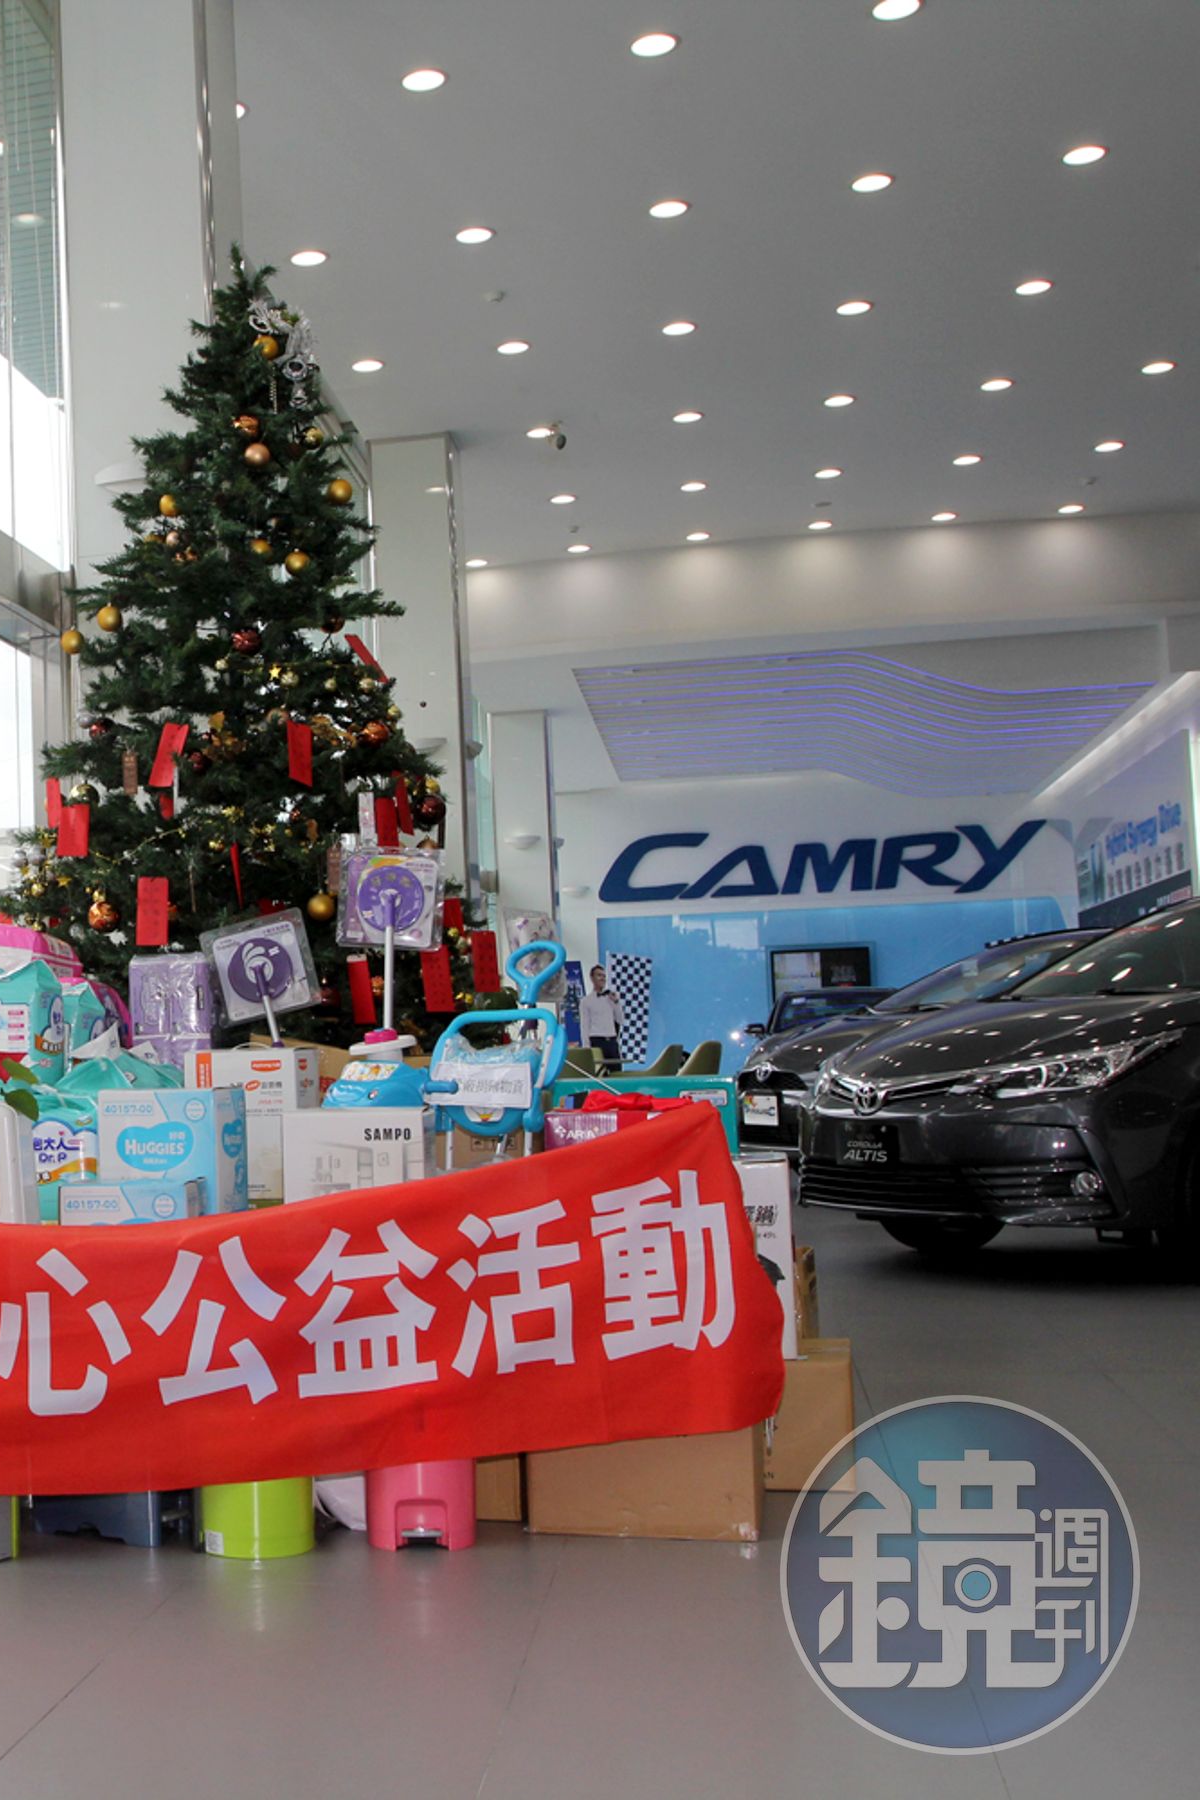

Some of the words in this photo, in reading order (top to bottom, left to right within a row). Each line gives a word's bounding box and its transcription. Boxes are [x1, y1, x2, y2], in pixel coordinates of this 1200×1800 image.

[599, 818, 1047, 902] CAMRY
[104, 1104, 152, 1114] 40157-00
[364, 1127, 412, 1141] SAMPO
[124, 1139, 185, 1156] HUGGIES
[847, 1140, 883, 1149] COROLLA
[843, 1149, 888, 1163] ALTIS
[66, 1199, 119, 1211] 40157-00
